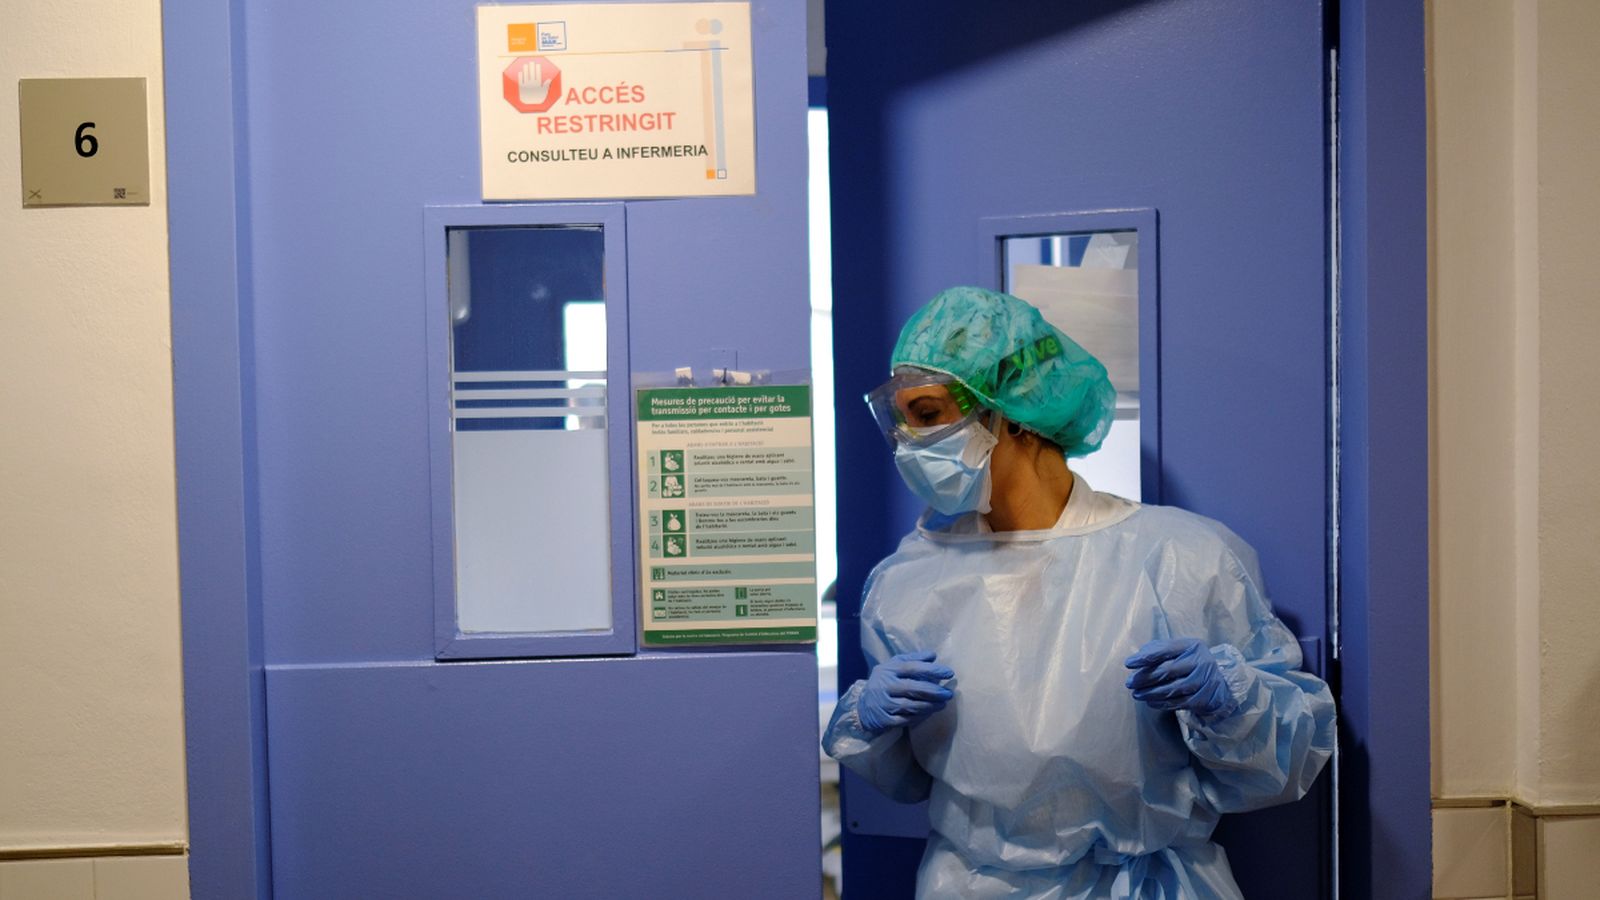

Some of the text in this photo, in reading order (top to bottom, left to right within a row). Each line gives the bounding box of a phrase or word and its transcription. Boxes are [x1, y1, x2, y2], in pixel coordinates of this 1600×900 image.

[565, 81, 645, 105] ACCÉS
[537, 112, 676, 135] RESTRINGIT
[75, 121, 98, 158] 6
[507, 144, 708, 163] CONSULTEU A INFERMERIA
[651, 394, 785, 407] Mesures de precaució per evitar la
[651, 406, 697, 415] transmissió
[698, 406, 712, 416] per
[714, 405, 747, 414] contacte
[754, 405, 767, 414] per
[769, 404, 792, 414] gotes
[650, 480, 657, 492] 2
[651, 515, 659, 527] 3
[651, 540, 659, 551] 4
